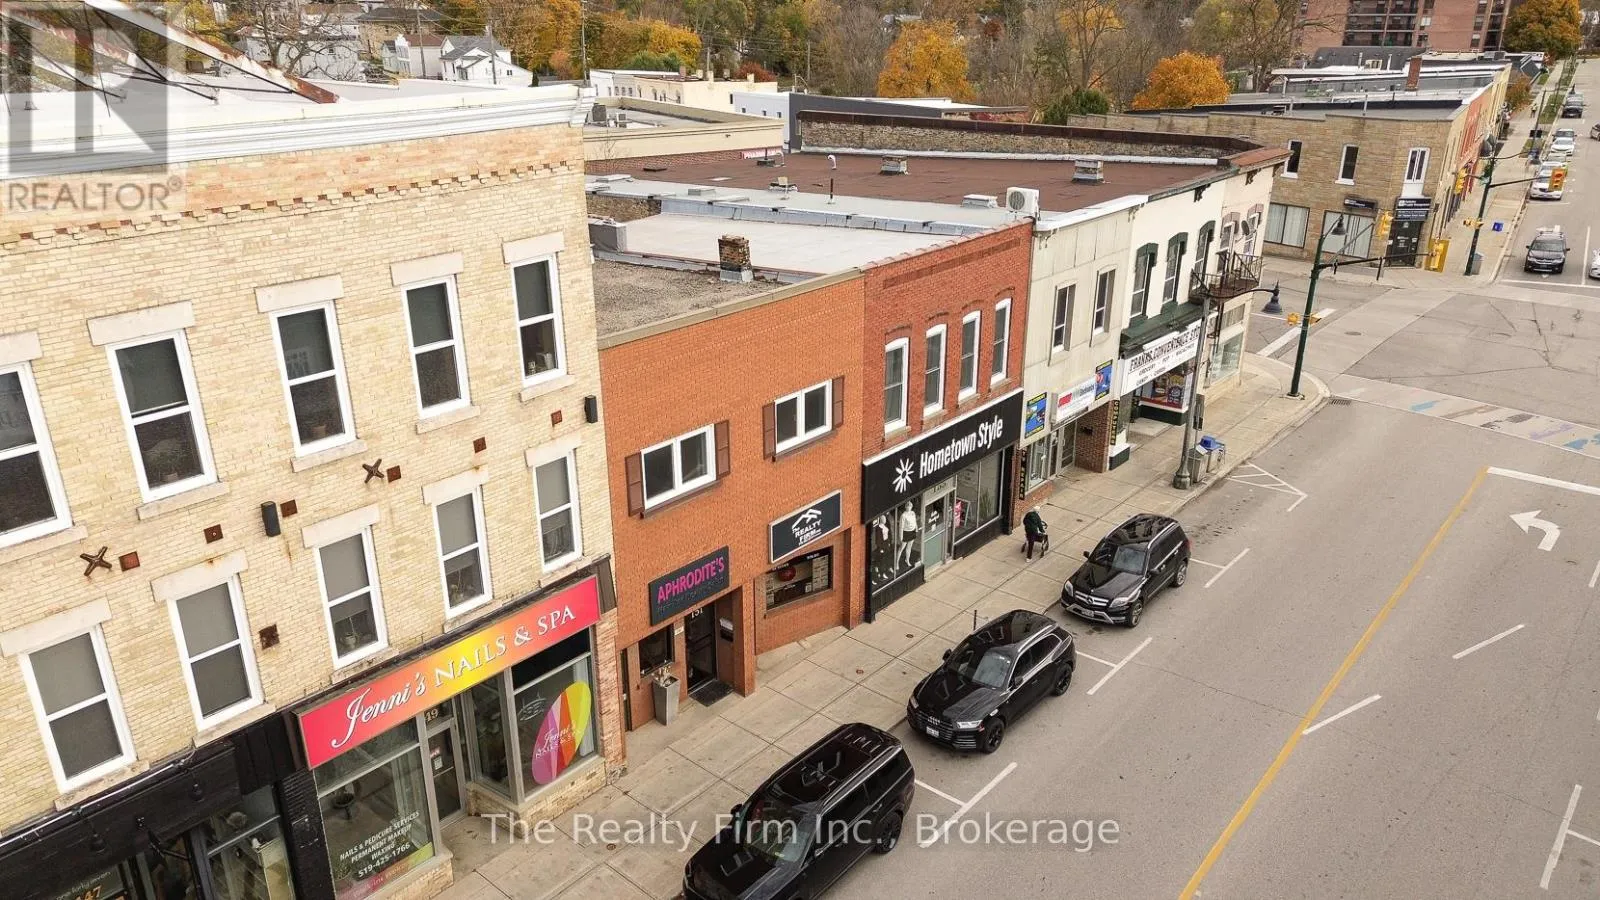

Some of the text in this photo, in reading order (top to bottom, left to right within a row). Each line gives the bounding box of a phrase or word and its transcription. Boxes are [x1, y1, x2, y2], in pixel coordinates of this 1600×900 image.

[919, 432, 977, 479] Hometown
[978, 415, 1003, 449] Style
[795, 519, 822, 538] REALTY
[657, 556, 725, 604] APHRODITE'S
[331, 605, 576, 748] Jenni's NAILS & SPA
[340, 844, 359, 861] NAILS
[364, 825, 393, 846] PEDICURE
[393, 811, 420, 829] SERVICES
[351, 838, 387, 863] PERMANENT
[358, 842, 411, 878] 519-425-1766
